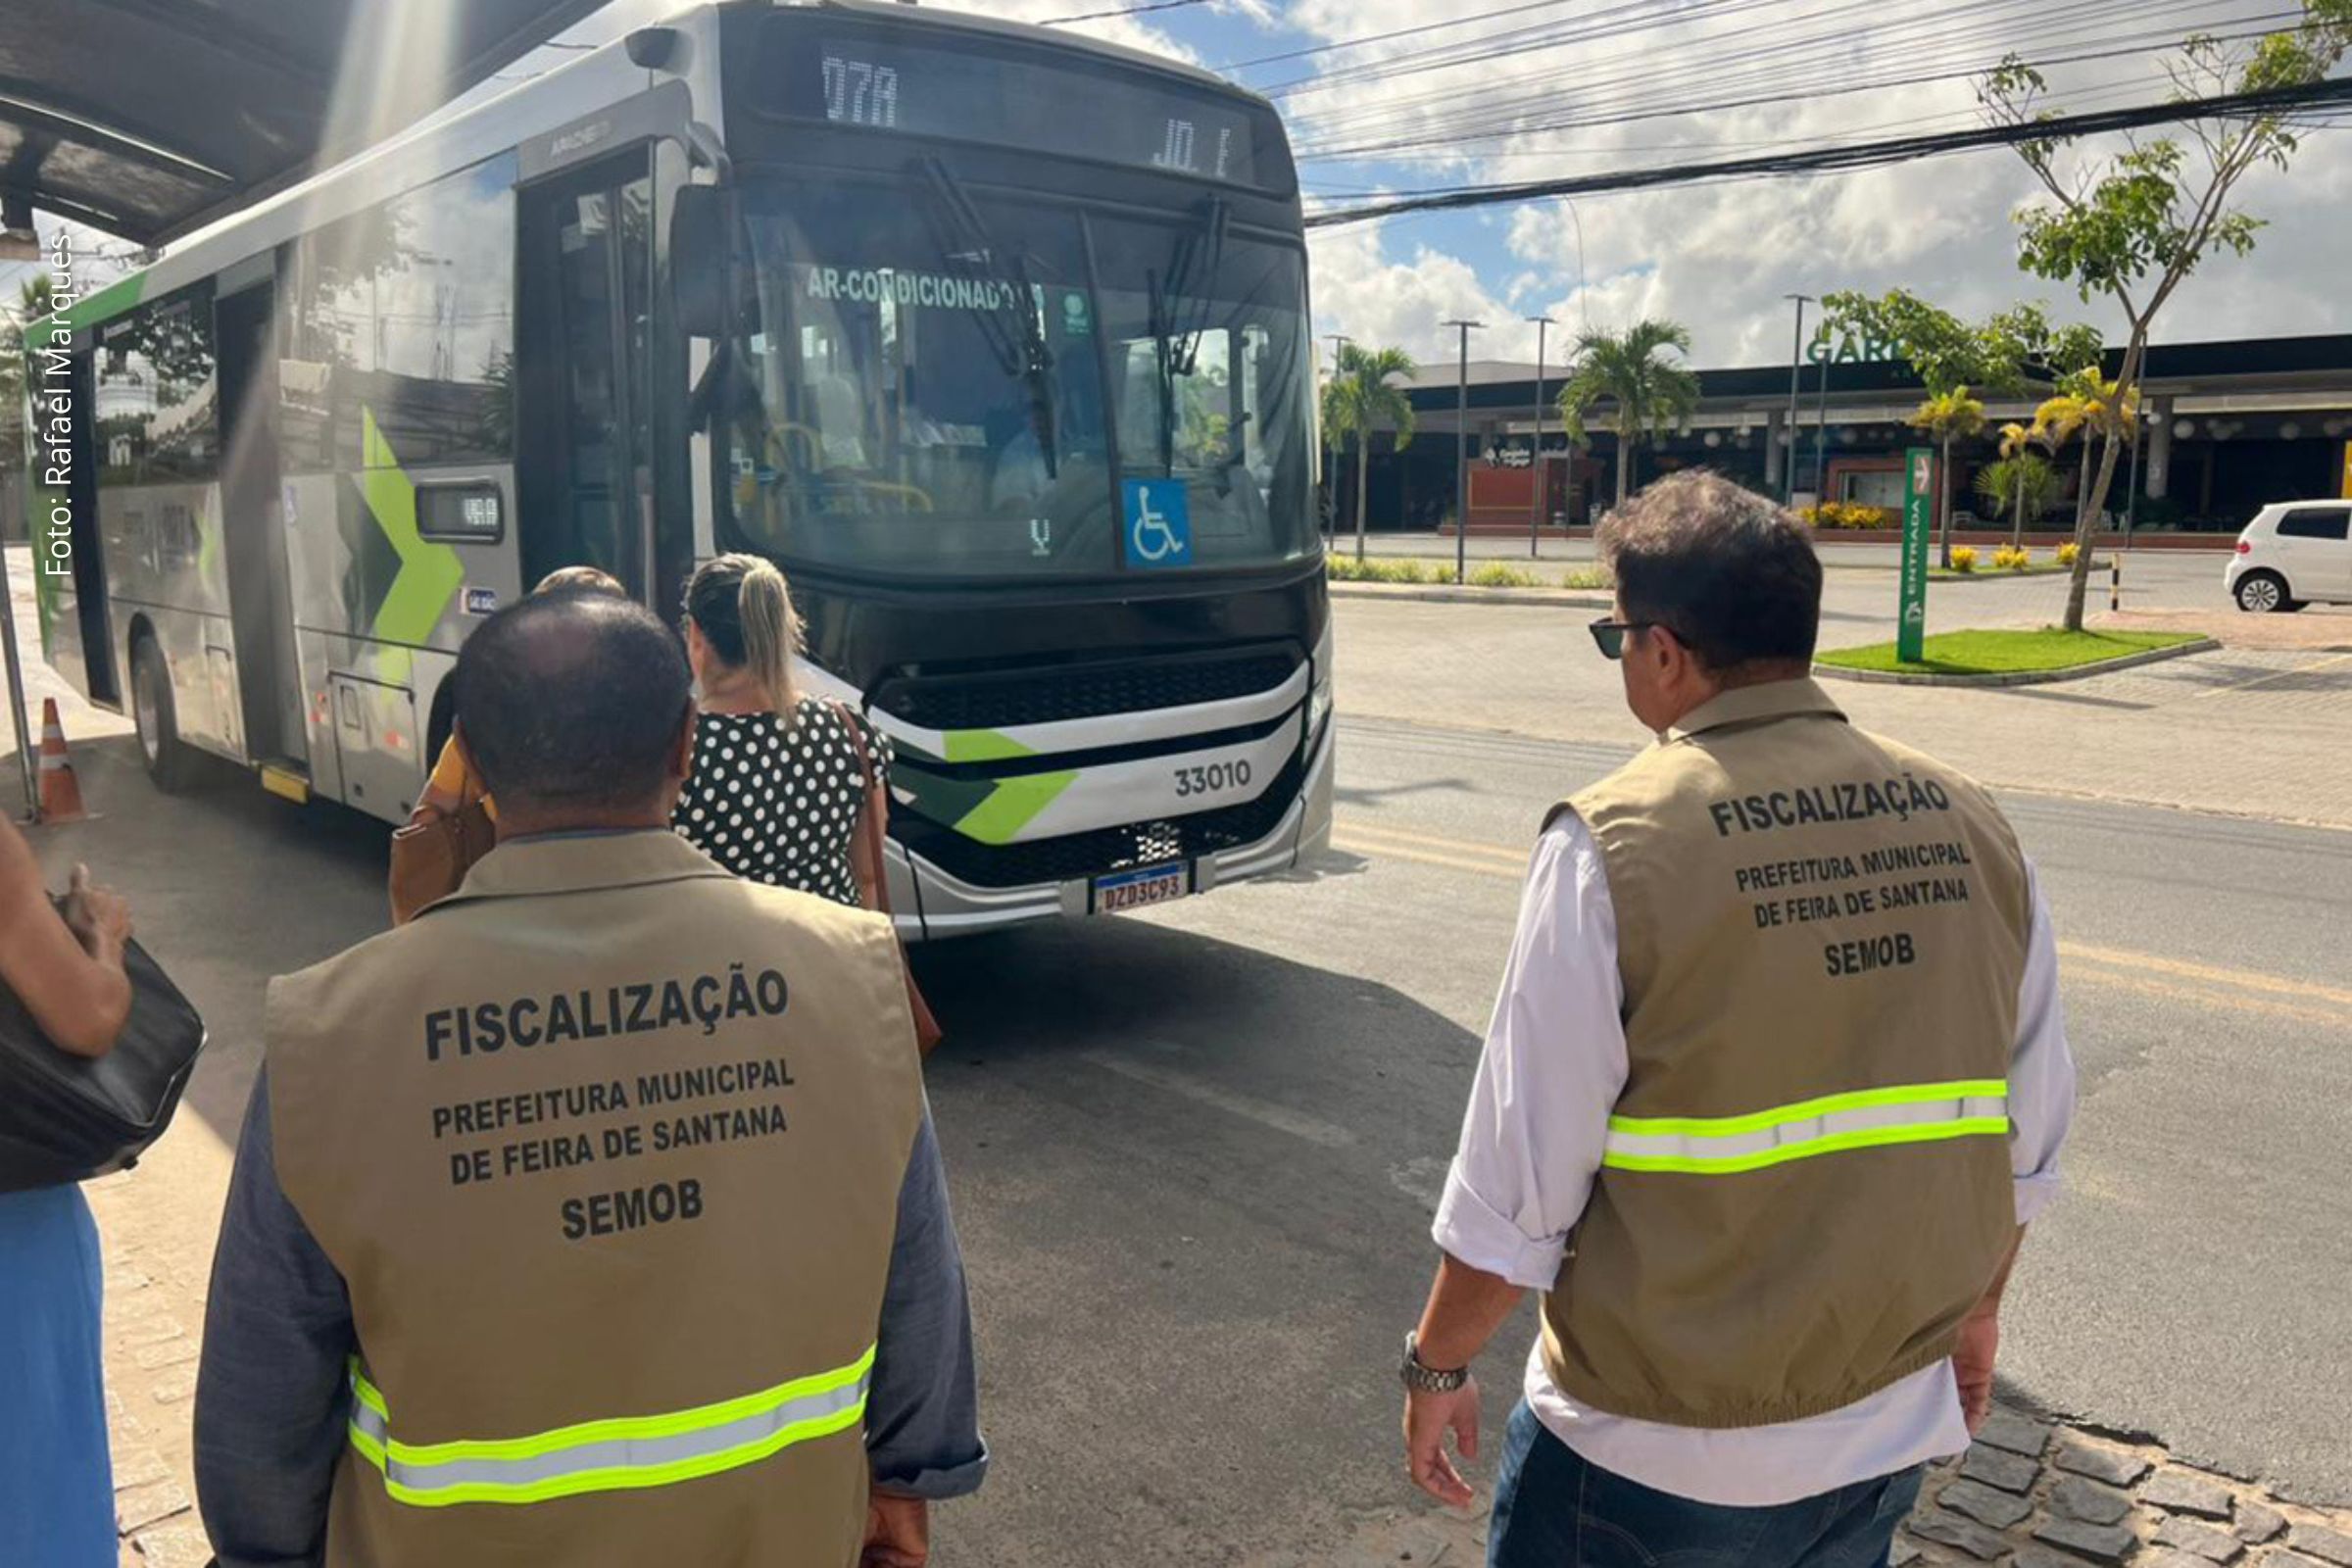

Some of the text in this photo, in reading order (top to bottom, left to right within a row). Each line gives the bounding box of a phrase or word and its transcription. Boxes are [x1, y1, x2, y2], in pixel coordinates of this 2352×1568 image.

[1907, 499, 1921, 596] ENTRADA
[1174, 759, 1251, 797] 33010
[1709, 772, 1950, 836] FISCALIZAÇÃO
[1736, 843, 1971, 892] PREFEITURA MUNICIPAL
[1754, 878, 1969, 928] DE FEIRA DE SANTANA
[1825, 933, 1916, 977] SEMOB
[425, 962, 788, 1060] FISCALIZAÇÃO
[432, 1058, 795, 1138] PREFEITURA MUNICIPAL
[451, 1104, 788, 1185] DE FEIRA DE SANTANA
[562, 1179, 704, 1240] SEMOB
